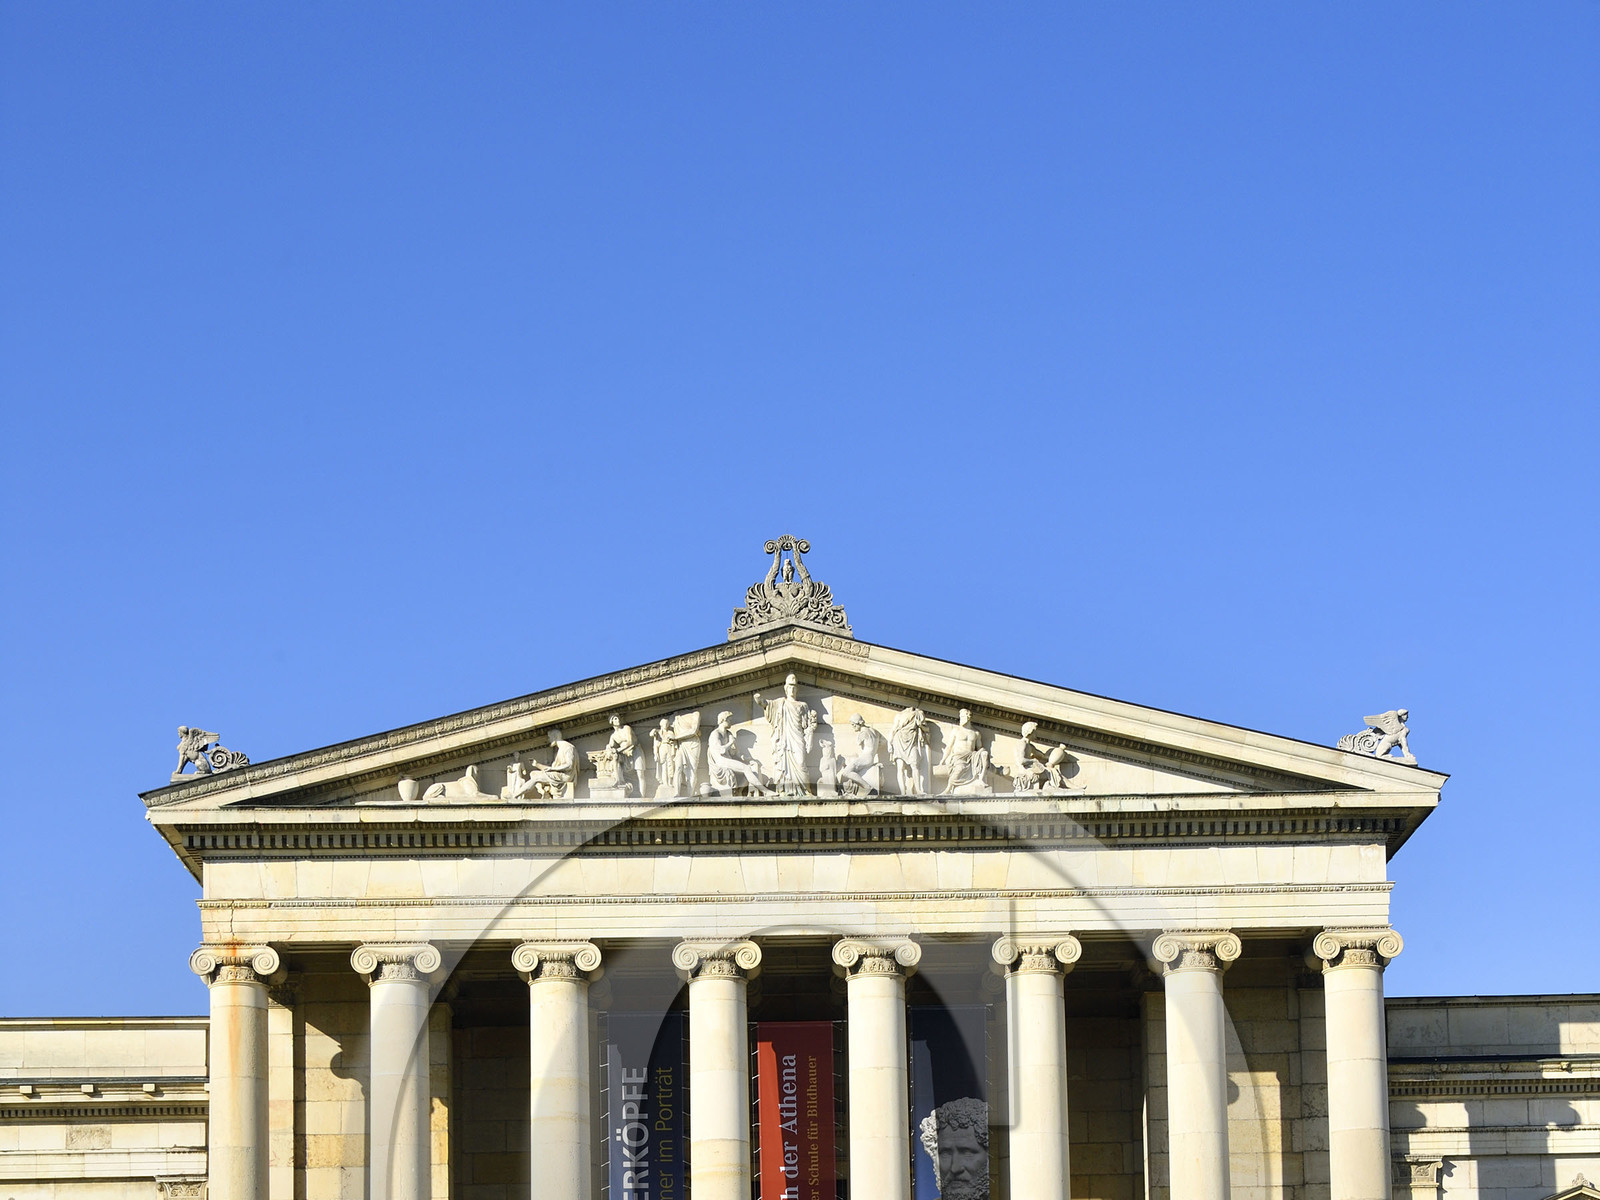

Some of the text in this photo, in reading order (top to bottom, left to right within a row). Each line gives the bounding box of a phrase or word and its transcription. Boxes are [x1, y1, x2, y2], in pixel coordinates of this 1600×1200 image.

[655, 1067, 673, 1131] Porträt
[778, 1054, 798, 1135] Athena
[807, 1056, 818, 1118] Bildhauer
[655, 1140, 673, 1162] im
[807, 1121, 819, 1140] für
[779, 1141, 799, 1179] der
[808, 1144, 820, 1185] Schule
